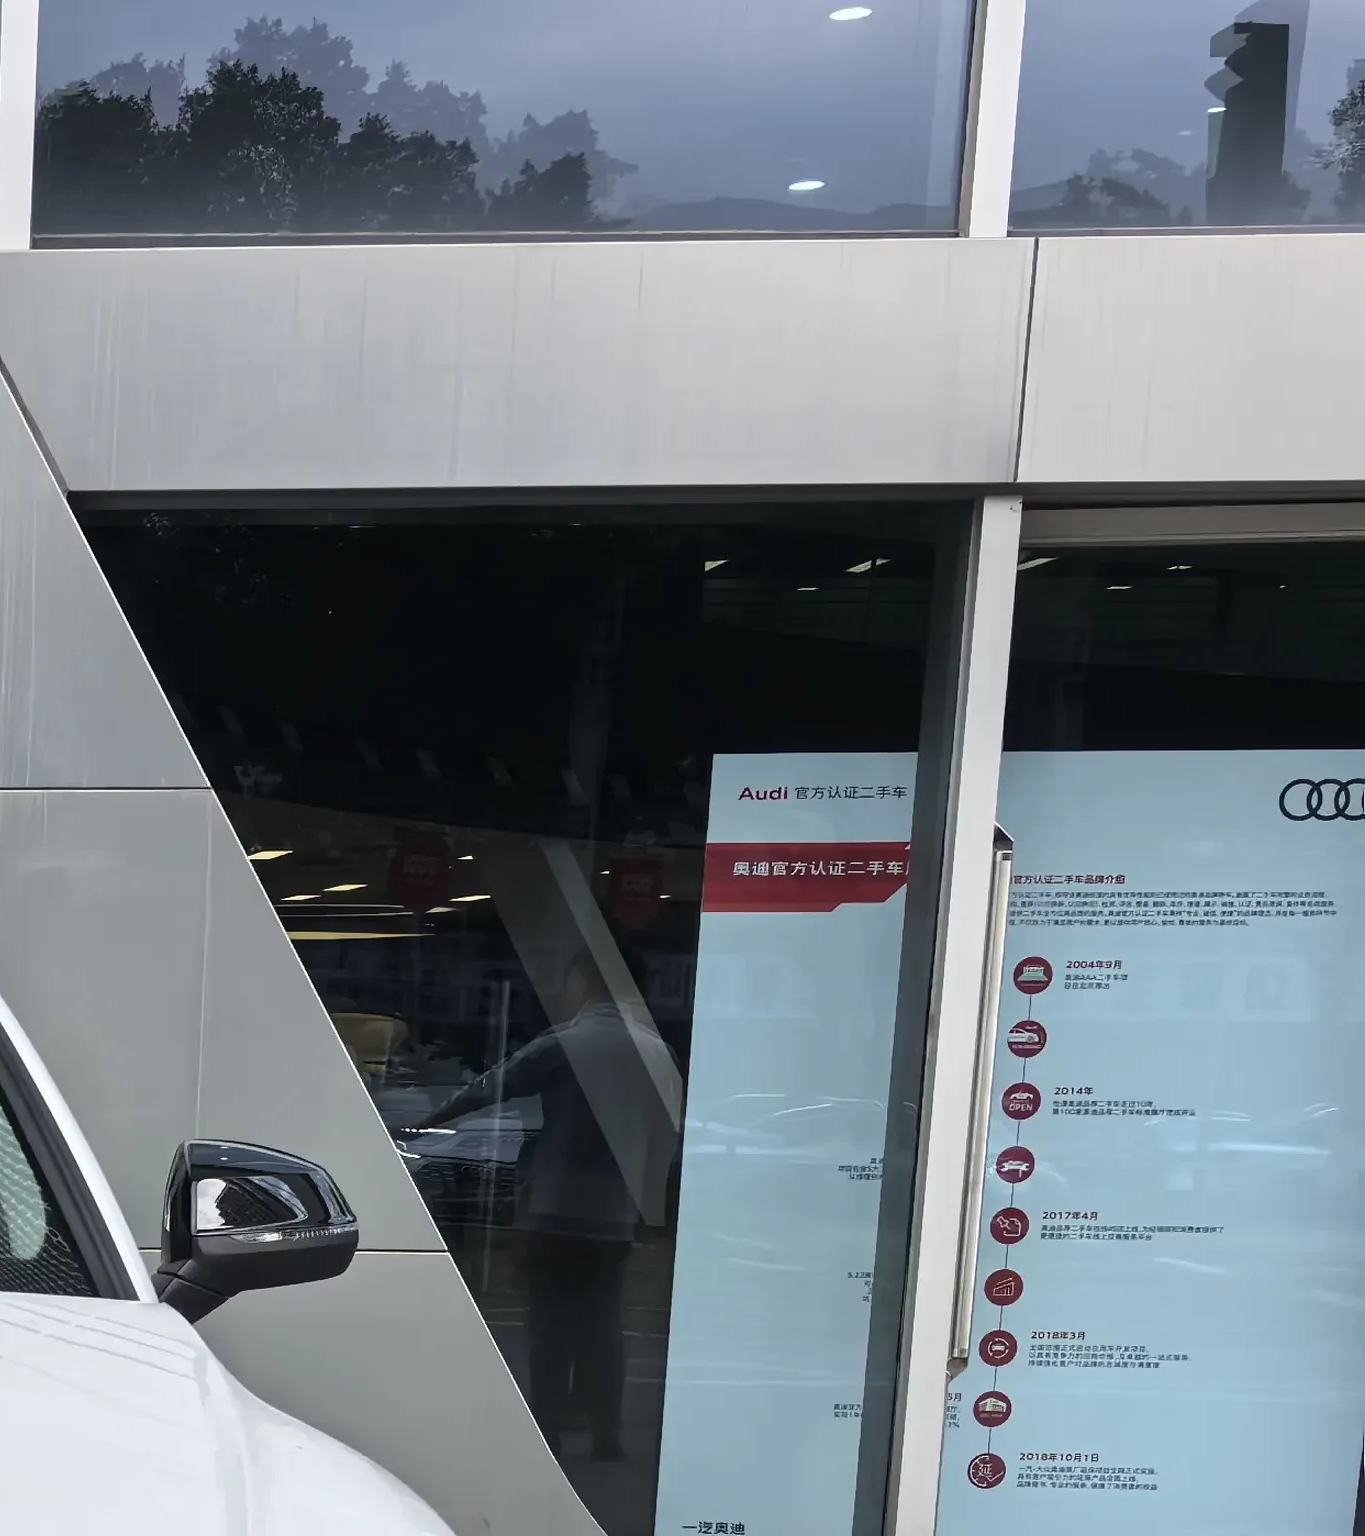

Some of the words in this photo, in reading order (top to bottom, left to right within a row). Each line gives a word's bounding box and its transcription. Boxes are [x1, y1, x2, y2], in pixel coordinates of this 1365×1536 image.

[738, 785, 788, 801] Audi
[794, 784, 909, 801] 官方认证二手车
[732, 860, 909, 877] 奥迪官方认证二手车
[1053, 1086, 1094, 1096] 2014年
[1008, 1103, 1033, 1112] OPEN
[1042, 1211, 1099, 1222] 2017年4月
[1030, 1330, 1086, 1342] 2018年3月
[1019, 1452, 1099, 1463] 2018年10月1日
[681, 1520, 746, 1536] 一汽奥迪
